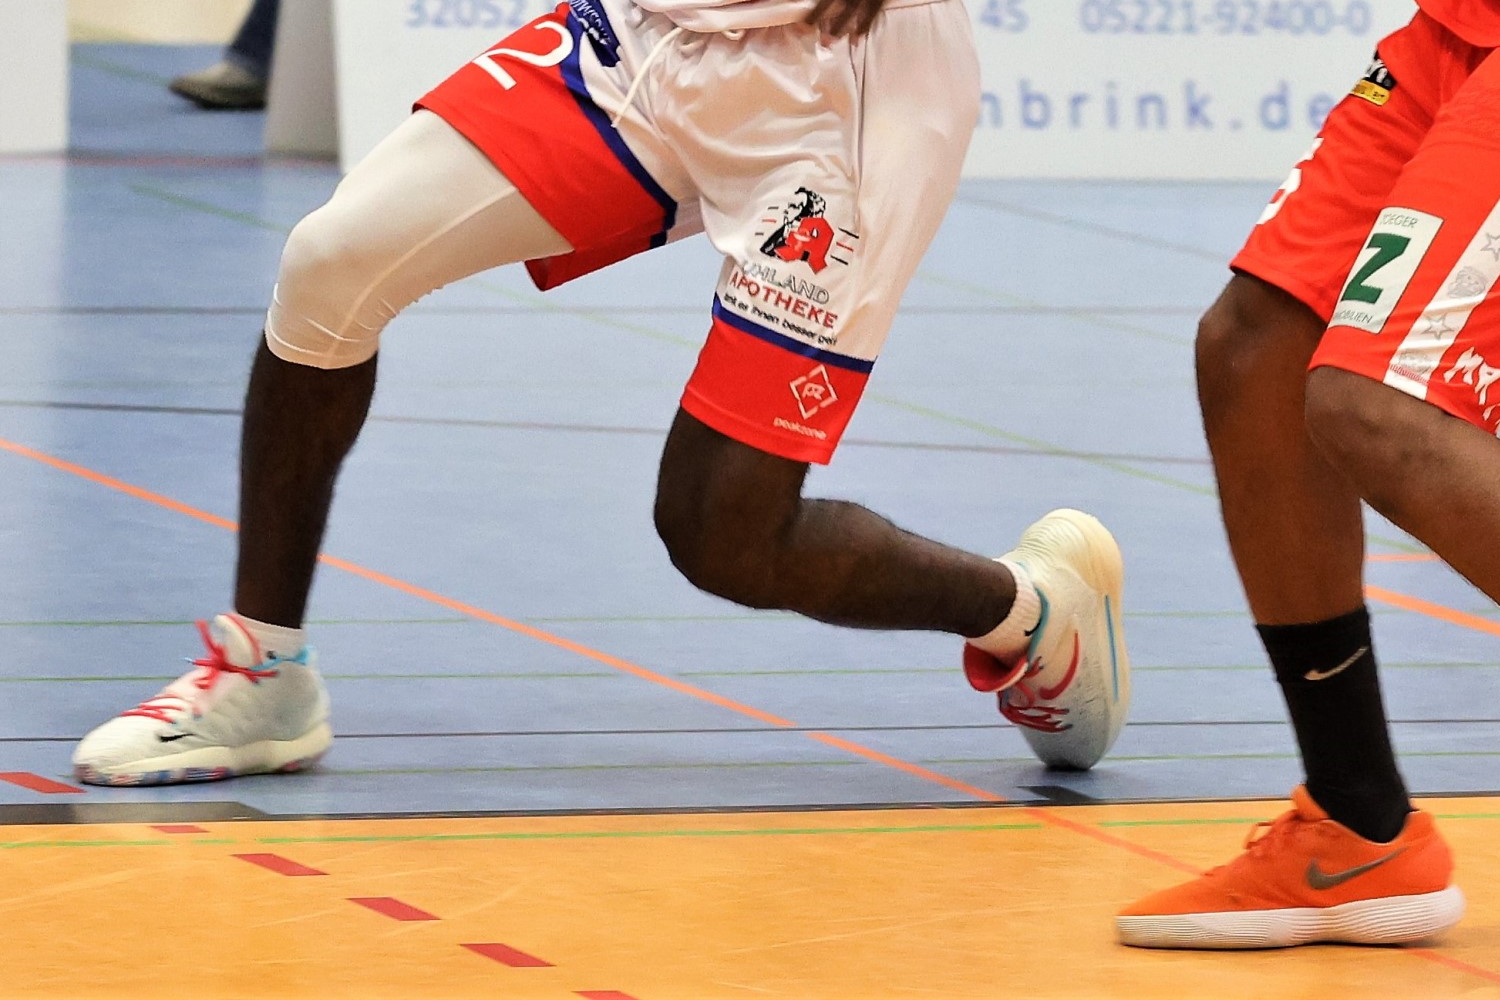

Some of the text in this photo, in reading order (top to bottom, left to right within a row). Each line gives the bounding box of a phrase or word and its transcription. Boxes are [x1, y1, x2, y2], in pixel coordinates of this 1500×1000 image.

[472, 20, 574, 91] 2
[729, 271, 839, 329] APOTHEKE
[1340, 232, 1412, 305] Z
